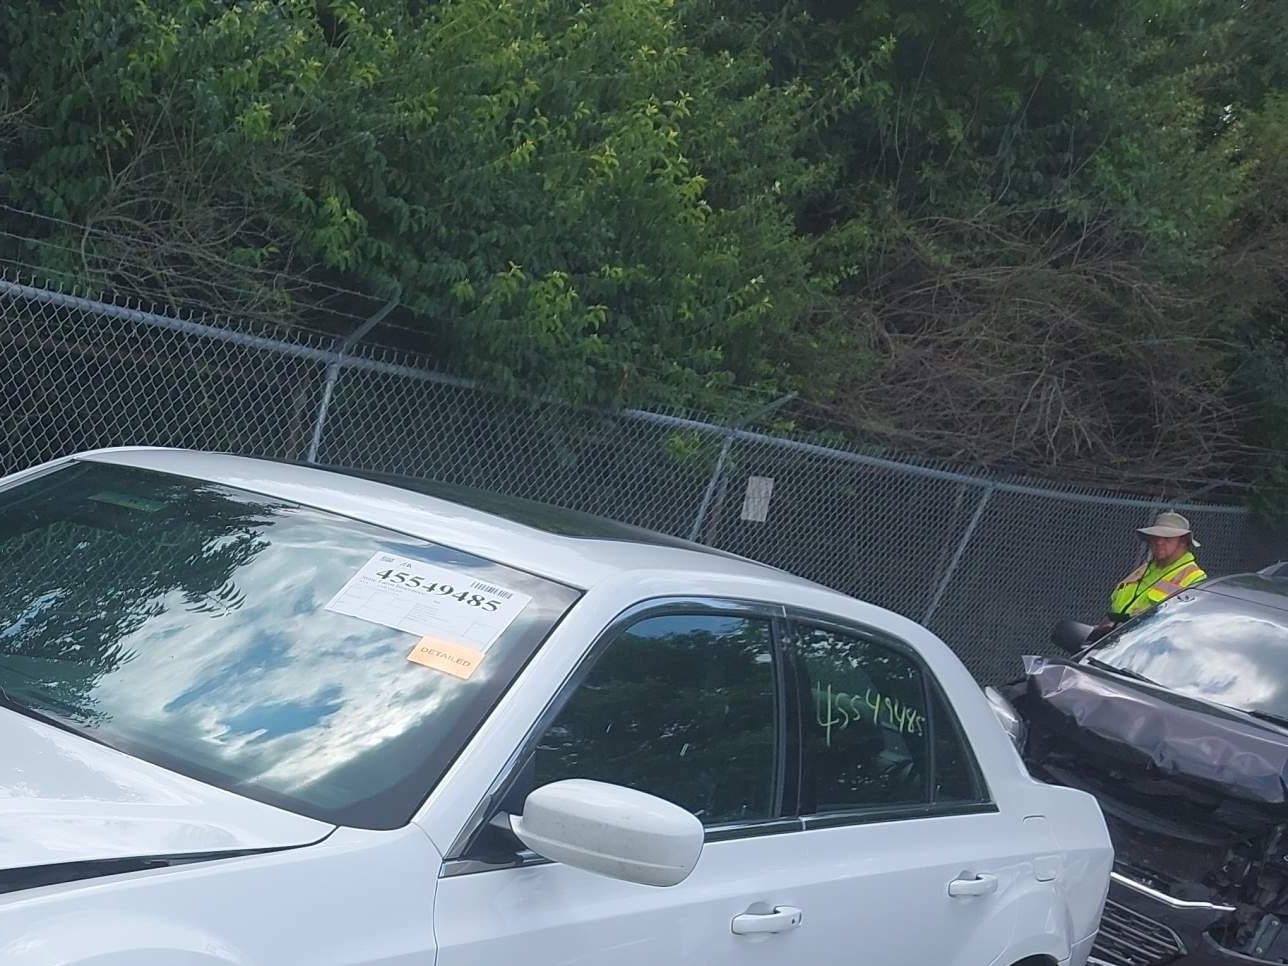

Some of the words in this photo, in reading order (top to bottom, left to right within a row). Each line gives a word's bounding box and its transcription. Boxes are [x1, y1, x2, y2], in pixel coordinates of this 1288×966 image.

[376, 569, 501, 612] 45549485
[420, 647, 471, 667] DETAILED
[815, 680, 926, 747] 45549485
